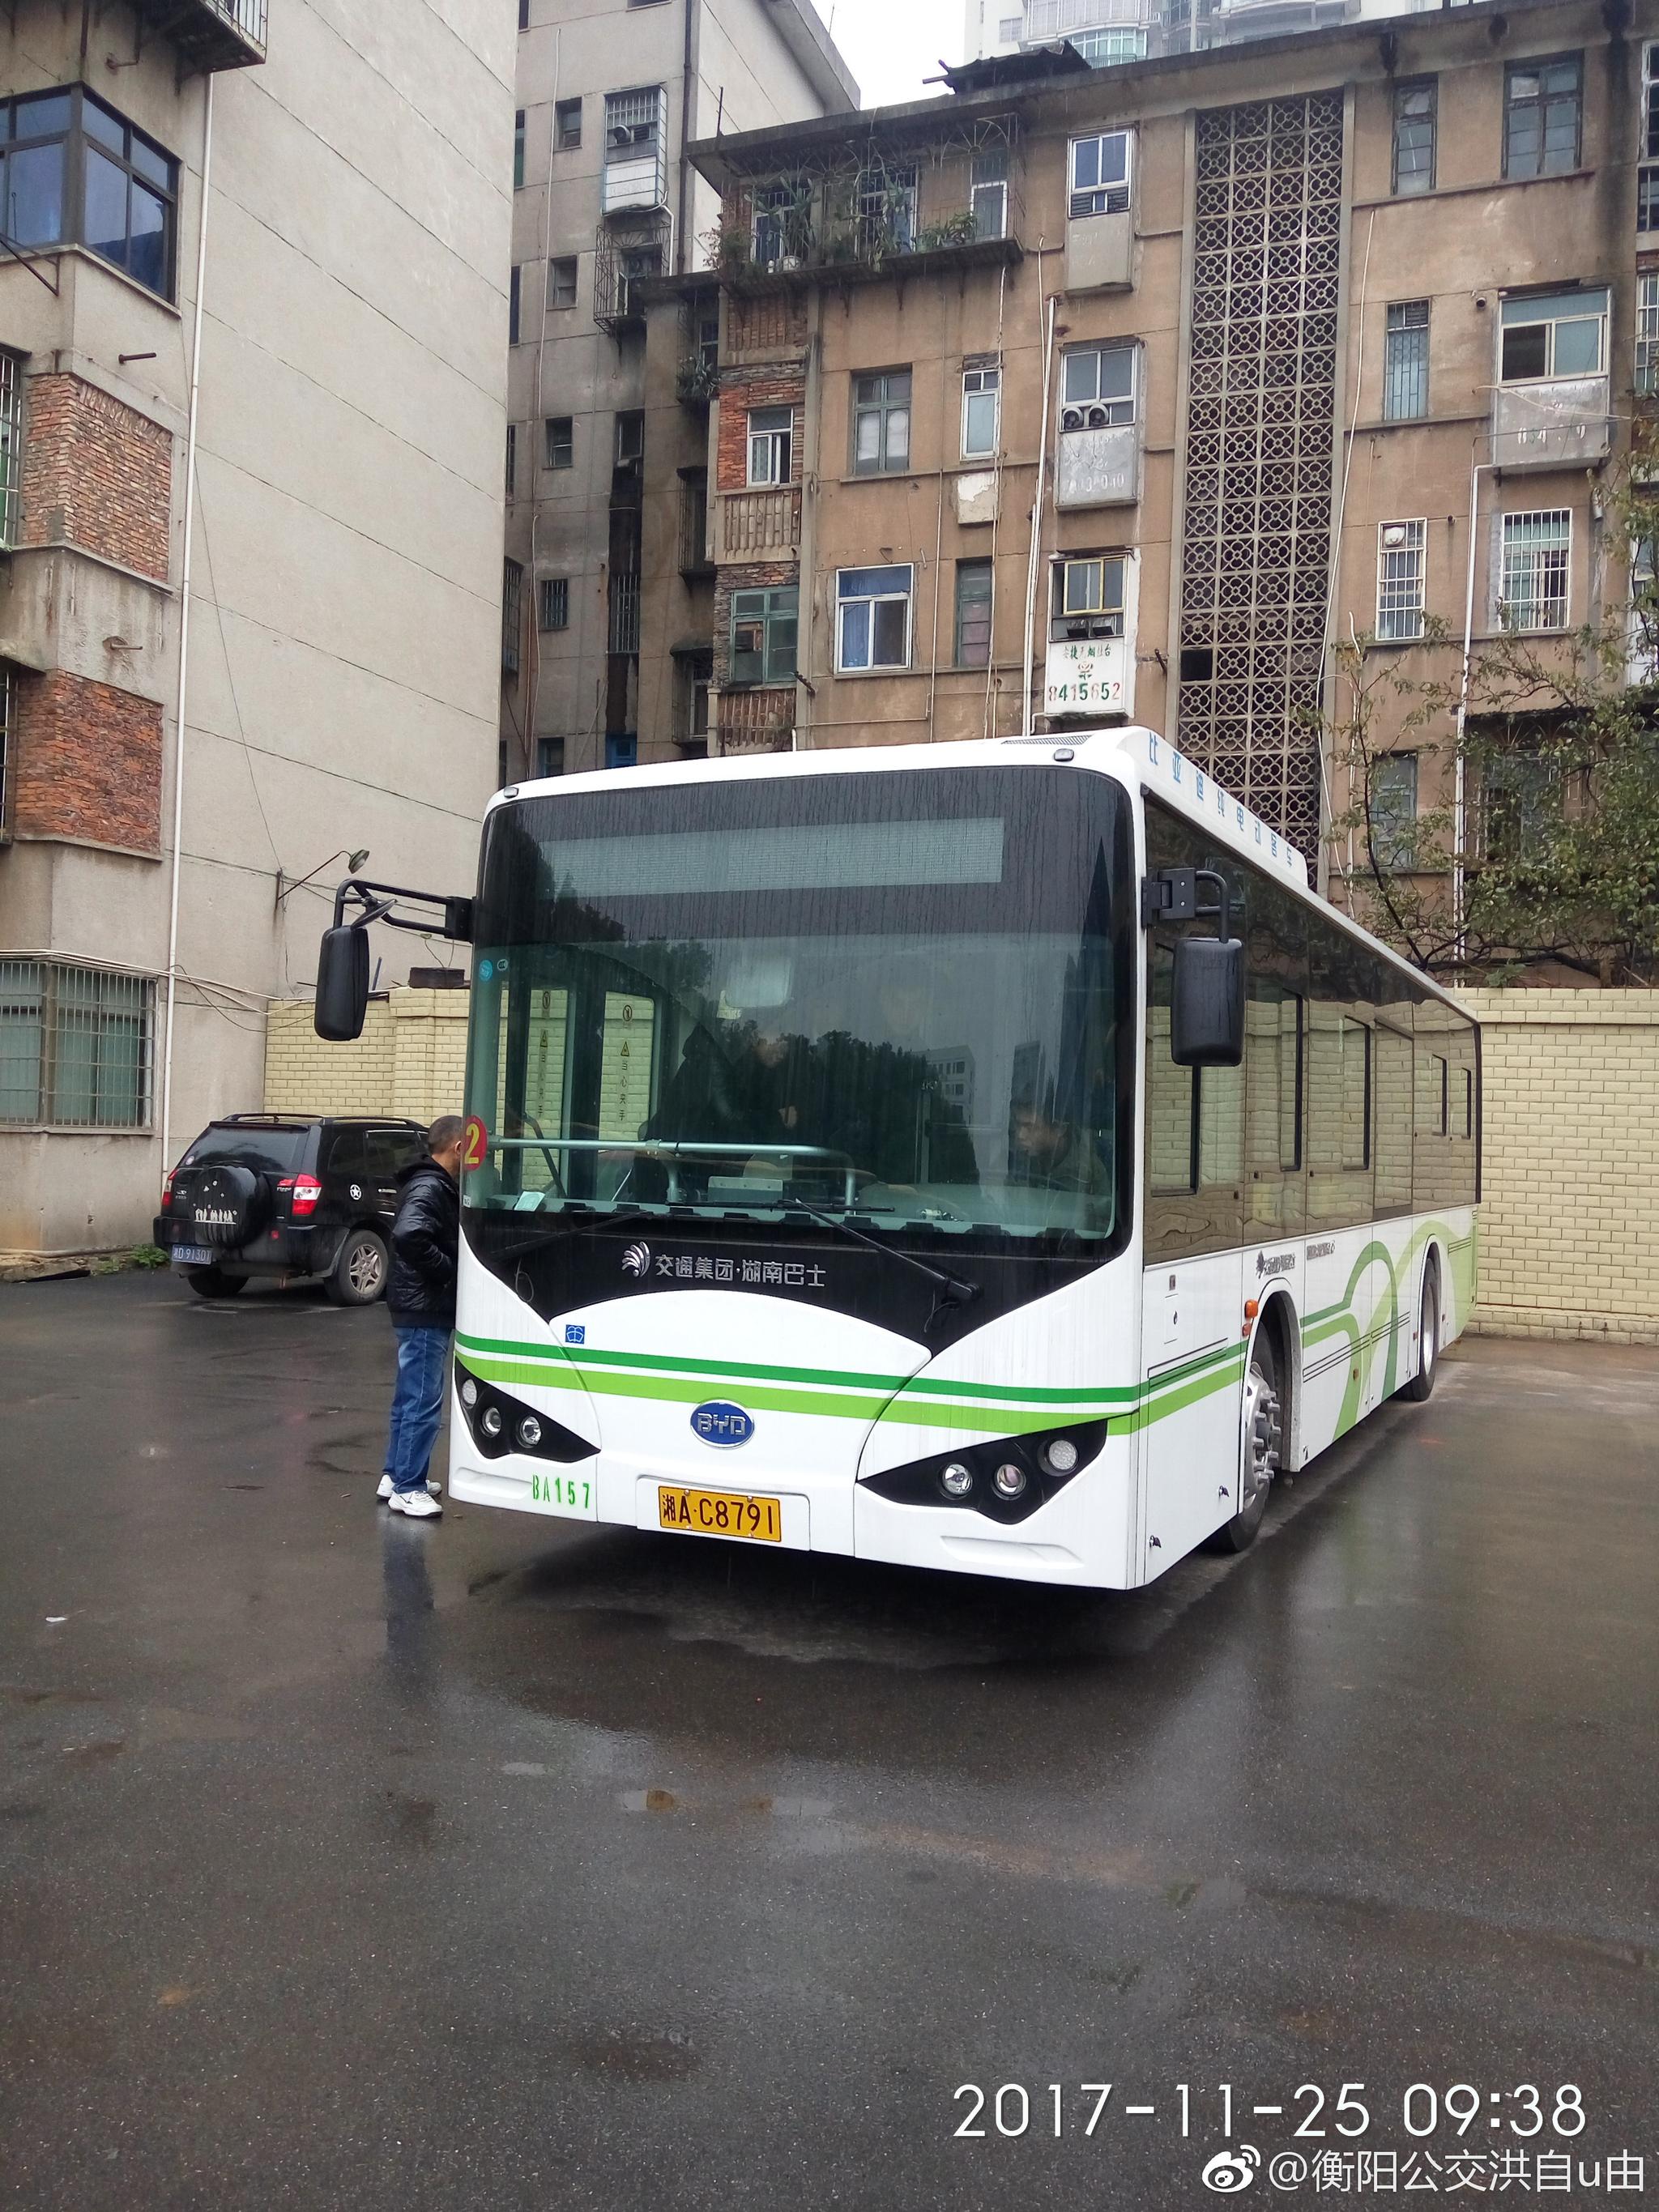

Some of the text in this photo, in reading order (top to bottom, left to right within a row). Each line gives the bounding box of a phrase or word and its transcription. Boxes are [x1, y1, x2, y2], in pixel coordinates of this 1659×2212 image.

[464, 1123, 480, 1165] 2
[697, 1412, 746, 1436] BYD
[532, 1474, 590, 1509] BA157
